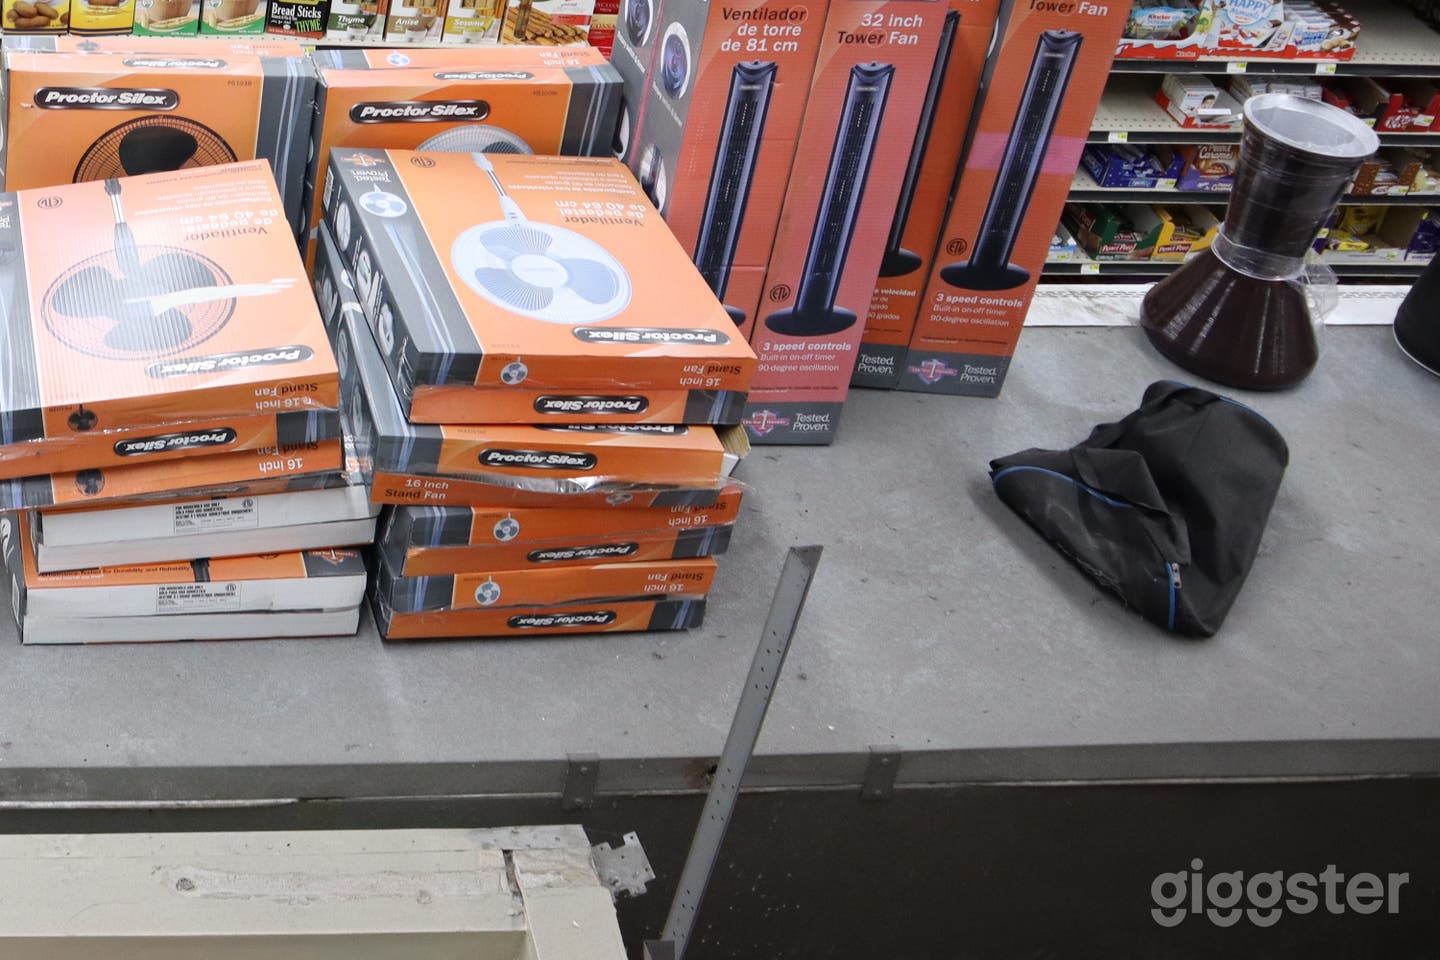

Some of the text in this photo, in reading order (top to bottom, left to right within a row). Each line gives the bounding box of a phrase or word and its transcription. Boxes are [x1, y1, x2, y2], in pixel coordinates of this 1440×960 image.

[272, 2, 322, 19] Bread Sticks
[723, 7, 807, 21] Ventilador
[1078, 2, 1109, 16] Fan
[294, 19, 322, 33] THYME
[337, 15, 365, 26] Thyme
[396, 17, 419, 26] Anise
[454, 18, 485, 27] Sesame
[861, 13, 923, 28] 32 inch
[737, 24, 802, 36] de torre
[837, 31, 920, 45] Tower Fan
[721, 39, 799, 52] de 81 cm
[45, 90, 167, 106] Proctor Silex
[359, 105, 479, 118] Proctor Silex
[560, 208, 644, 219] de pedestal
[629, 204, 647, 212] de
[564, 216, 644, 227] Ventilador
[184, 226, 268, 241] Ventilador
[880, 289, 916, 297] velocidad
[936, 293, 1023, 307] 3 speed controls
[985, 308, 1008, 316] timer
[970, 317, 1010, 327] oscillation
[589, 330, 718, 343] Proctor Silex
[763, 342, 852, 352] 3 speed controls
[160, 348, 301, 375] Proctor Silex
[861, 354, 895, 366] Tested.
[683, 364, 743, 374] Stand Fan
[858, 363, 894, 375] Proven.
[964, 364, 998, 376] Tested.
[679, 378, 721, 387] 16 inch
[960, 373, 996, 384] Proven.
[255, 383, 318, 397] Stand Fan
[255, 399, 279, 410] inch
[545, 398, 640, 411] Proctor Silex
[795, 412, 830, 423] Tested.
[792, 422, 830, 431] Proven.
[125, 431, 228, 453] Proctor Silex
[260, 458, 304, 472] 16 inch
[487, 452, 588, 466] Proctor Silex
[405, 480, 449, 490] 16 inch
[385, 489, 447, 500] Stand Fan
[668, 515, 709, 527] 16 inch
[538, 544, 632, 560] Proctor Silex
[647, 572, 705, 582] Stand Fan
[643, 583, 685, 593] 16 inch
[518, 612, 609, 626] Proctor Silex
